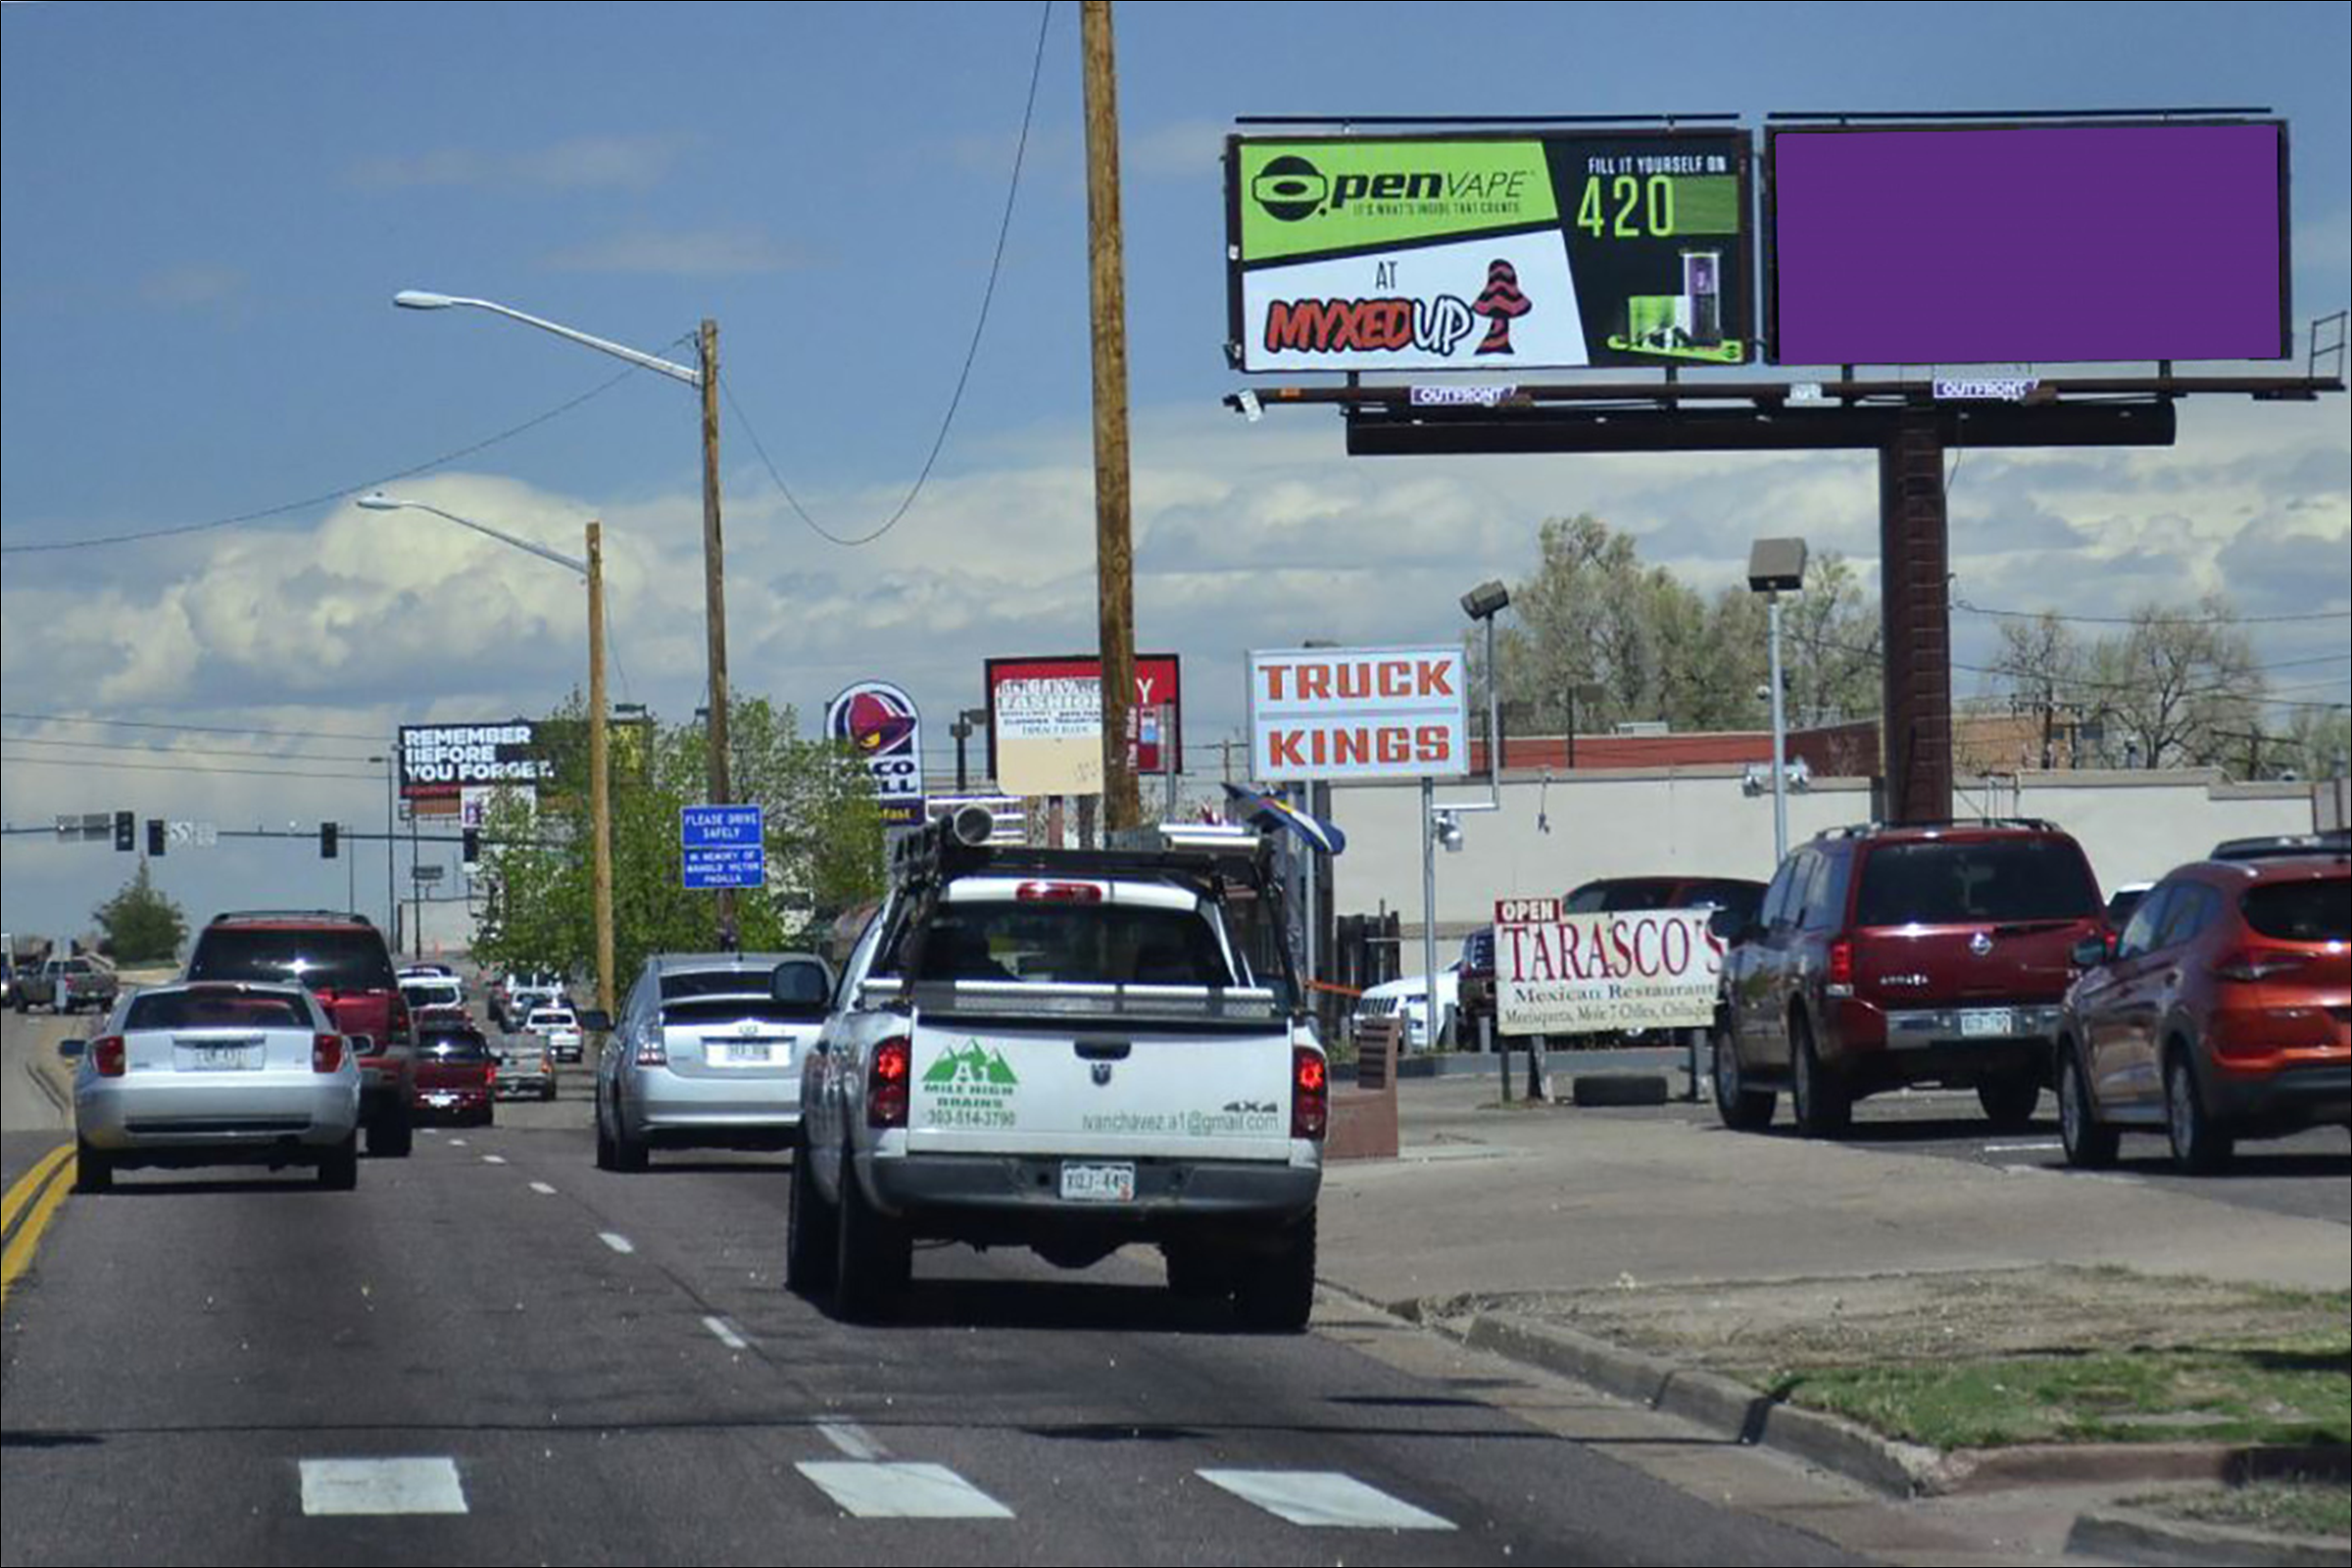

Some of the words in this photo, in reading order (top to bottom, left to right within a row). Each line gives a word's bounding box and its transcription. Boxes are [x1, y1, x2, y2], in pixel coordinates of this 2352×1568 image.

[1589, 156, 1615, 174] FILL
[1619, 157, 1632, 173] IT
[1638, 156, 1702, 173] YOURSELF
[1707, 156, 1727, 172] ON
[1578, 174, 1674, 237] 420
[1376, 261, 1397, 289] AT
[1258, 660, 1453, 701] TRUCK
[404, 727, 531, 746] REMEMBER
[1269, 725, 1449, 767] KINGS
[405, 745, 496, 764] BEFORE
[405, 764, 454, 782] YOU
[685, 813, 723, 826] PLEASE
[1501, 902, 1554, 921] OPEN
[1502, 917, 1723, 983] TARASCO'S
[1515, 985, 1601, 1004] Mexican
[1608, 980, 1715, 1000] Restaurant
